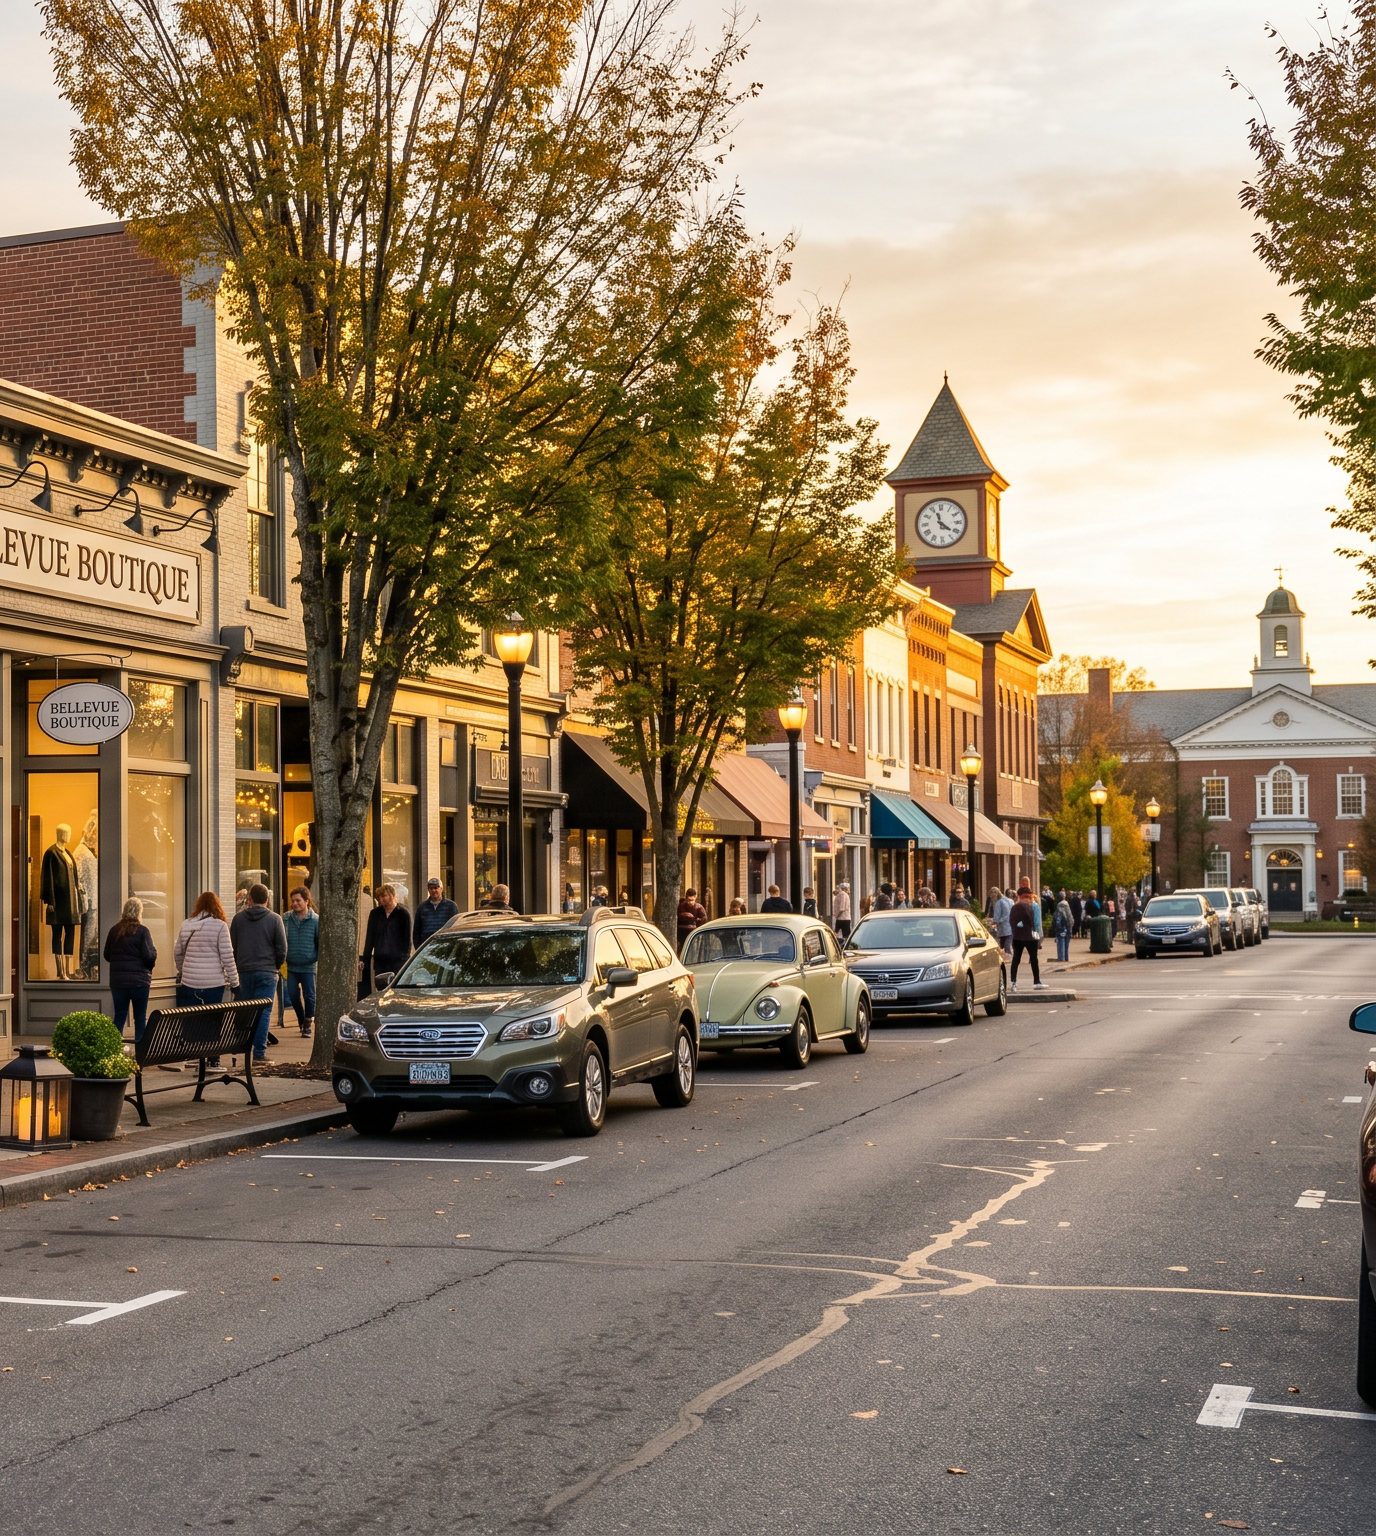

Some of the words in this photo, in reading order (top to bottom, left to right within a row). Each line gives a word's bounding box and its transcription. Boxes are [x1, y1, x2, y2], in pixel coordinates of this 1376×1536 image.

[77, 544, 189, 605] BOUTIQUE
[50, 701, 119, 714] BELLEVUE
[50, 716, 119, 730] BOUTIQUE
